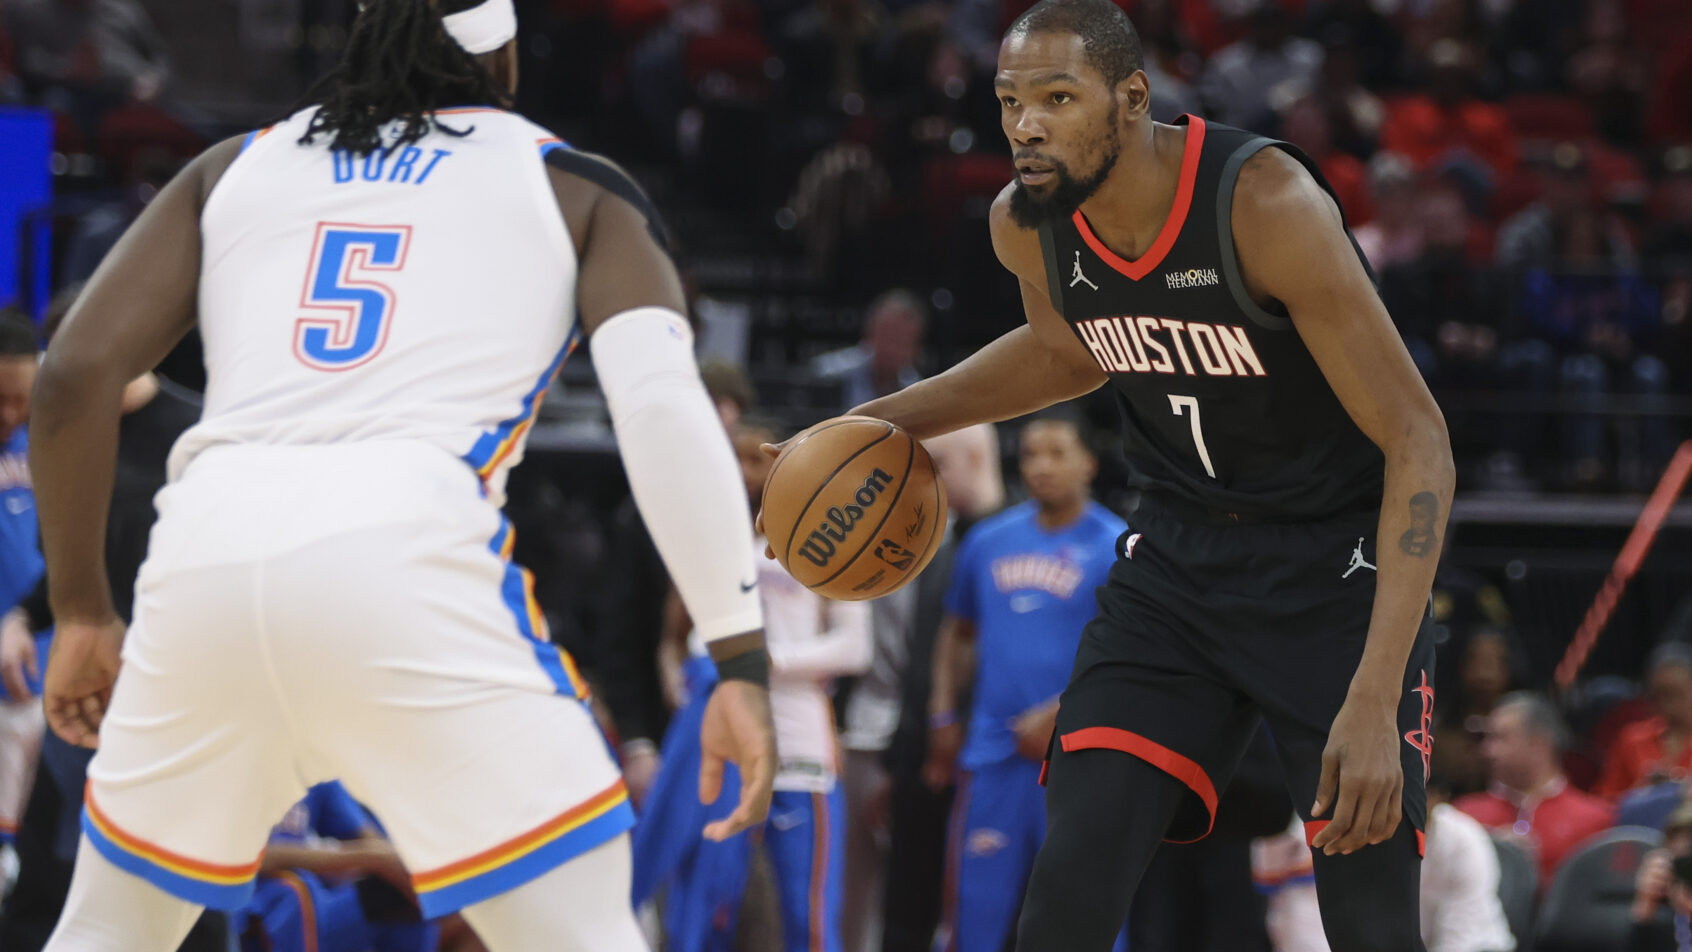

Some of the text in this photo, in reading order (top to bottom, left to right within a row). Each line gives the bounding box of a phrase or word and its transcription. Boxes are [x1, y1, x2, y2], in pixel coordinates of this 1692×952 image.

[333, 146, 452, 185] DORT
[292, 221, 413, 373] 5
[1165, 268, 1218, 281] MEMORIAL
[1167, 276, 1219, 289] HERMANN
[1075, 315, 1268, 377] HOUSTON
[1166, 393, 1216, 479] 7
[797, 467, 894, 567] Wilson
